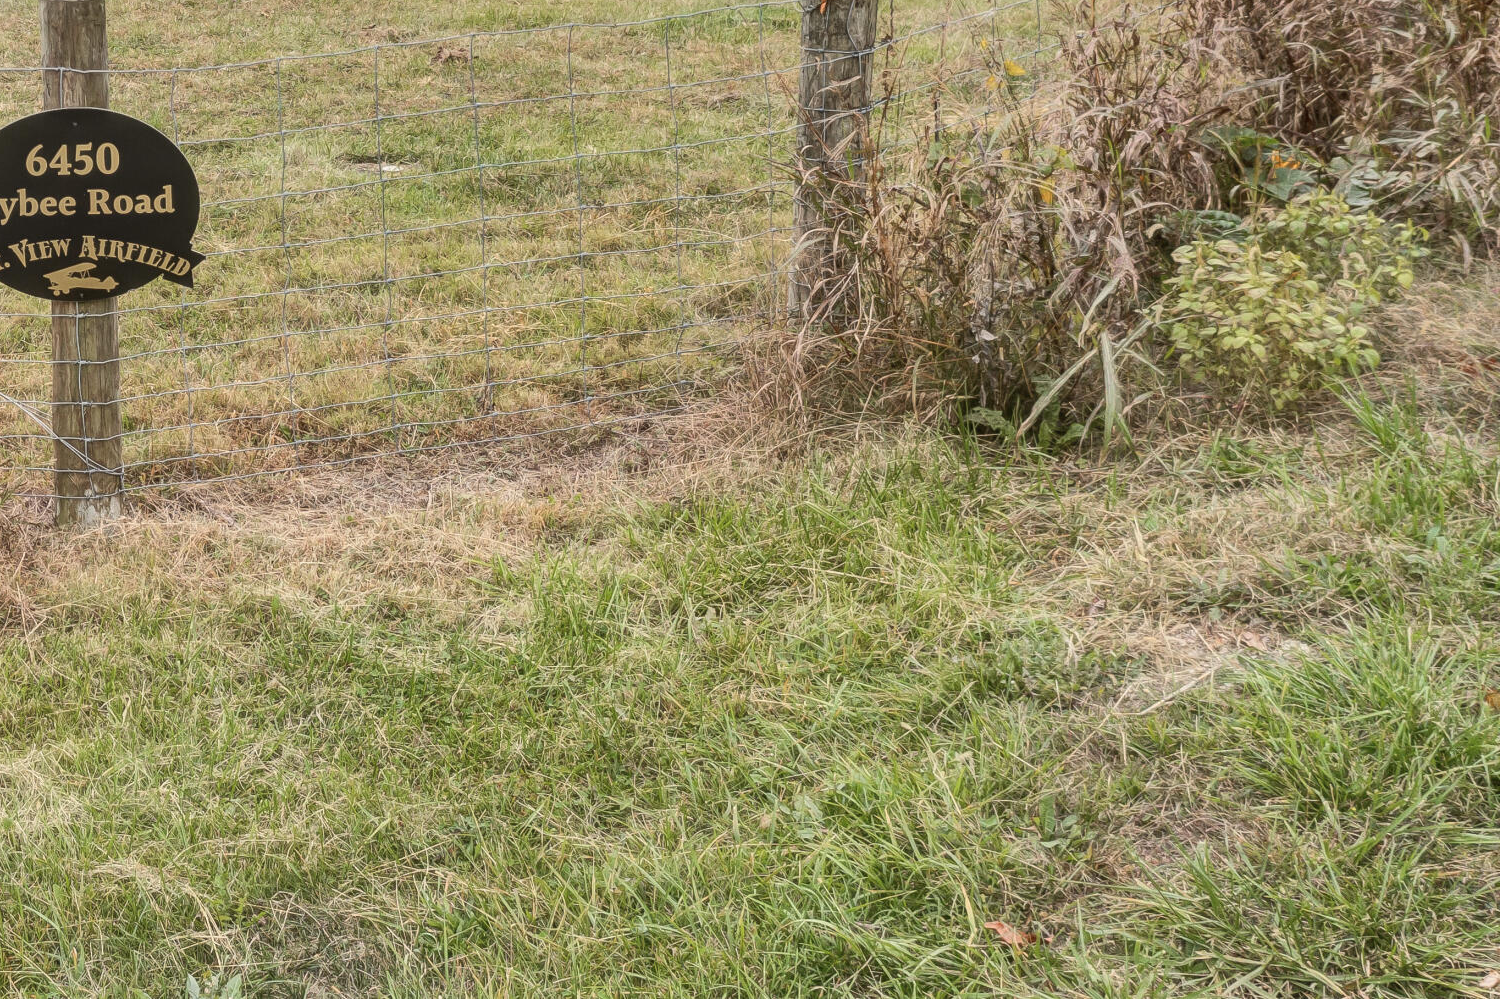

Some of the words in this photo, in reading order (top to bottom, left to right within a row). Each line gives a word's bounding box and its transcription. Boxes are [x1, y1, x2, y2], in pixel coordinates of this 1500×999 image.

[25, 141, 120, 177] 6450
[87, 184, 176, 216] Road
[8, 237, 72, 268] VIEW
[79, 235, 192, 277] AIRFIELD
